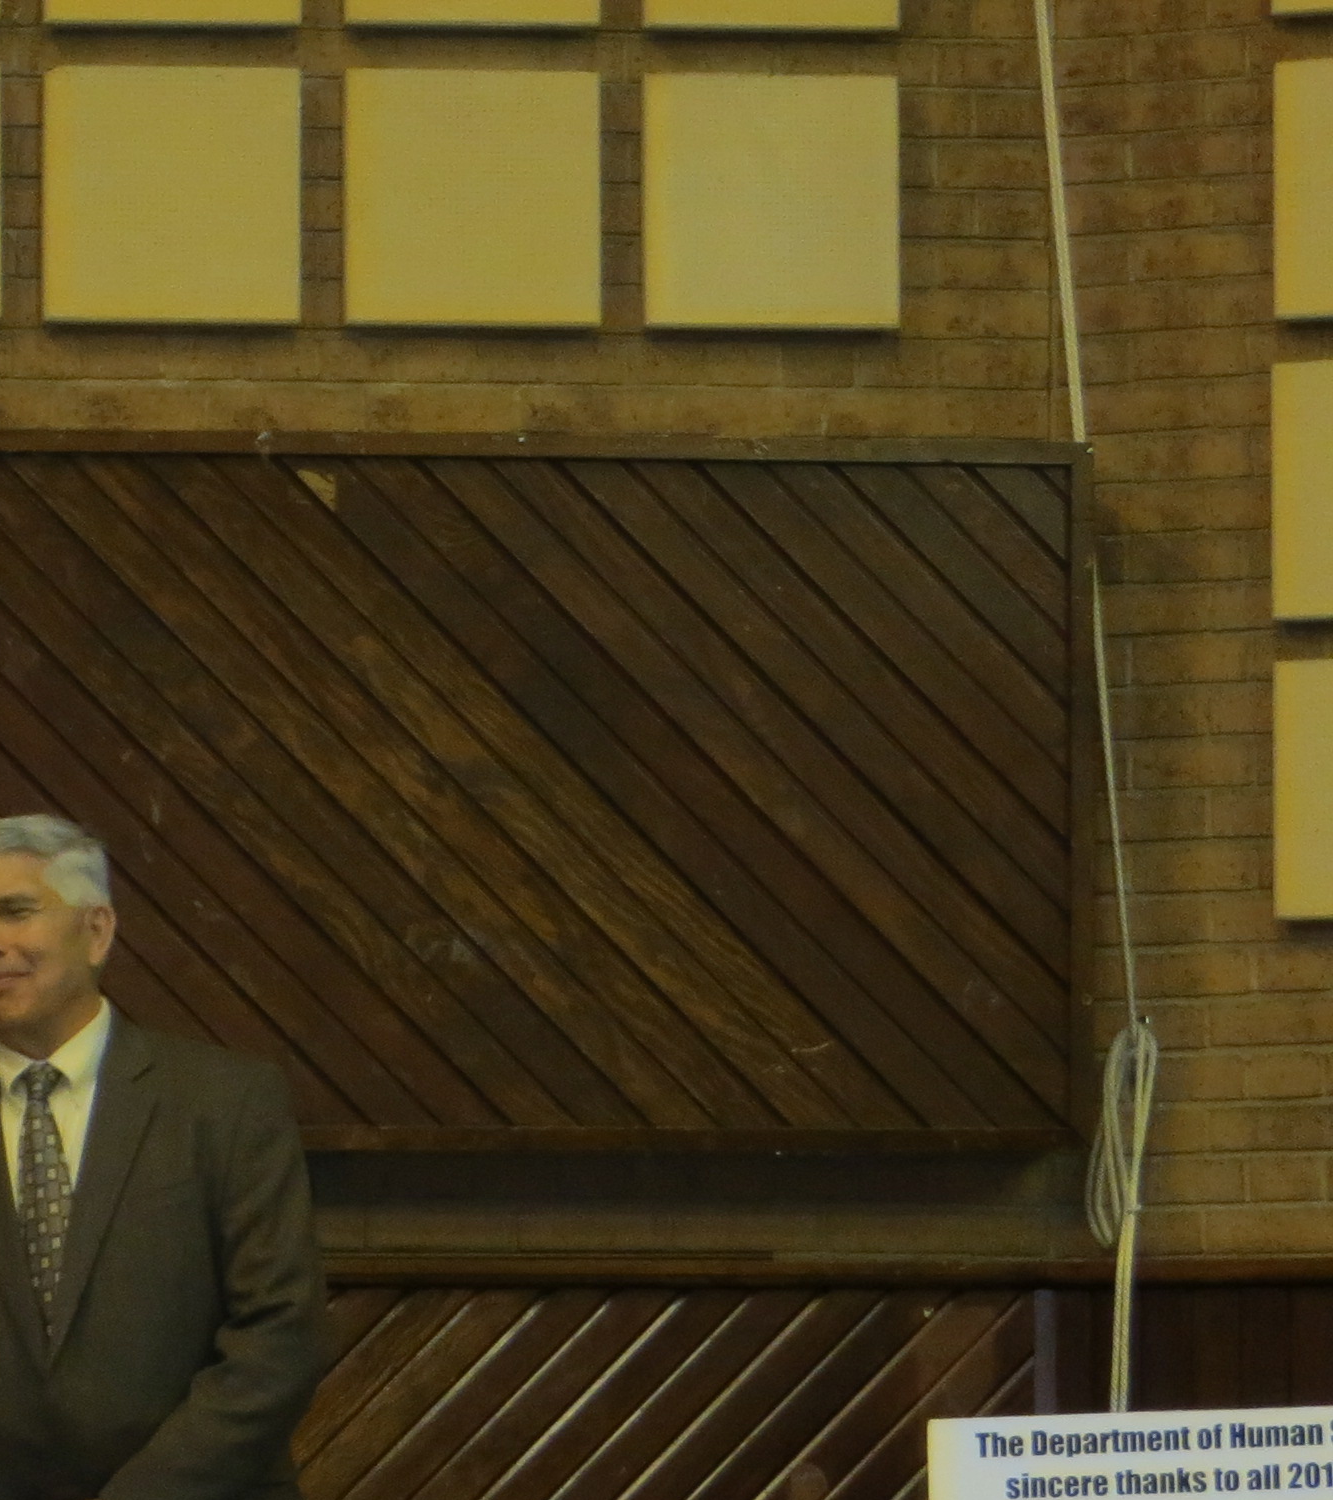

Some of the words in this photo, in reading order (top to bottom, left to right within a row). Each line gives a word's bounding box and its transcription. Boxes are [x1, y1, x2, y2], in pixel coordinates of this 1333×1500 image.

[975, 1431, 1025, 1459] The
[1032, 1425, 1191, 1458] Department
[1198, 1424, 1223, 1450] of
[1230, 1422, 1323, 1449] Human
[1006, 1472, 1109, 1500] sincere
[1115, 1467, 1208, 1496] thanks
[1213, 1467, 1241, 1492] to
[1247, 1464, 1281, 1491] all
